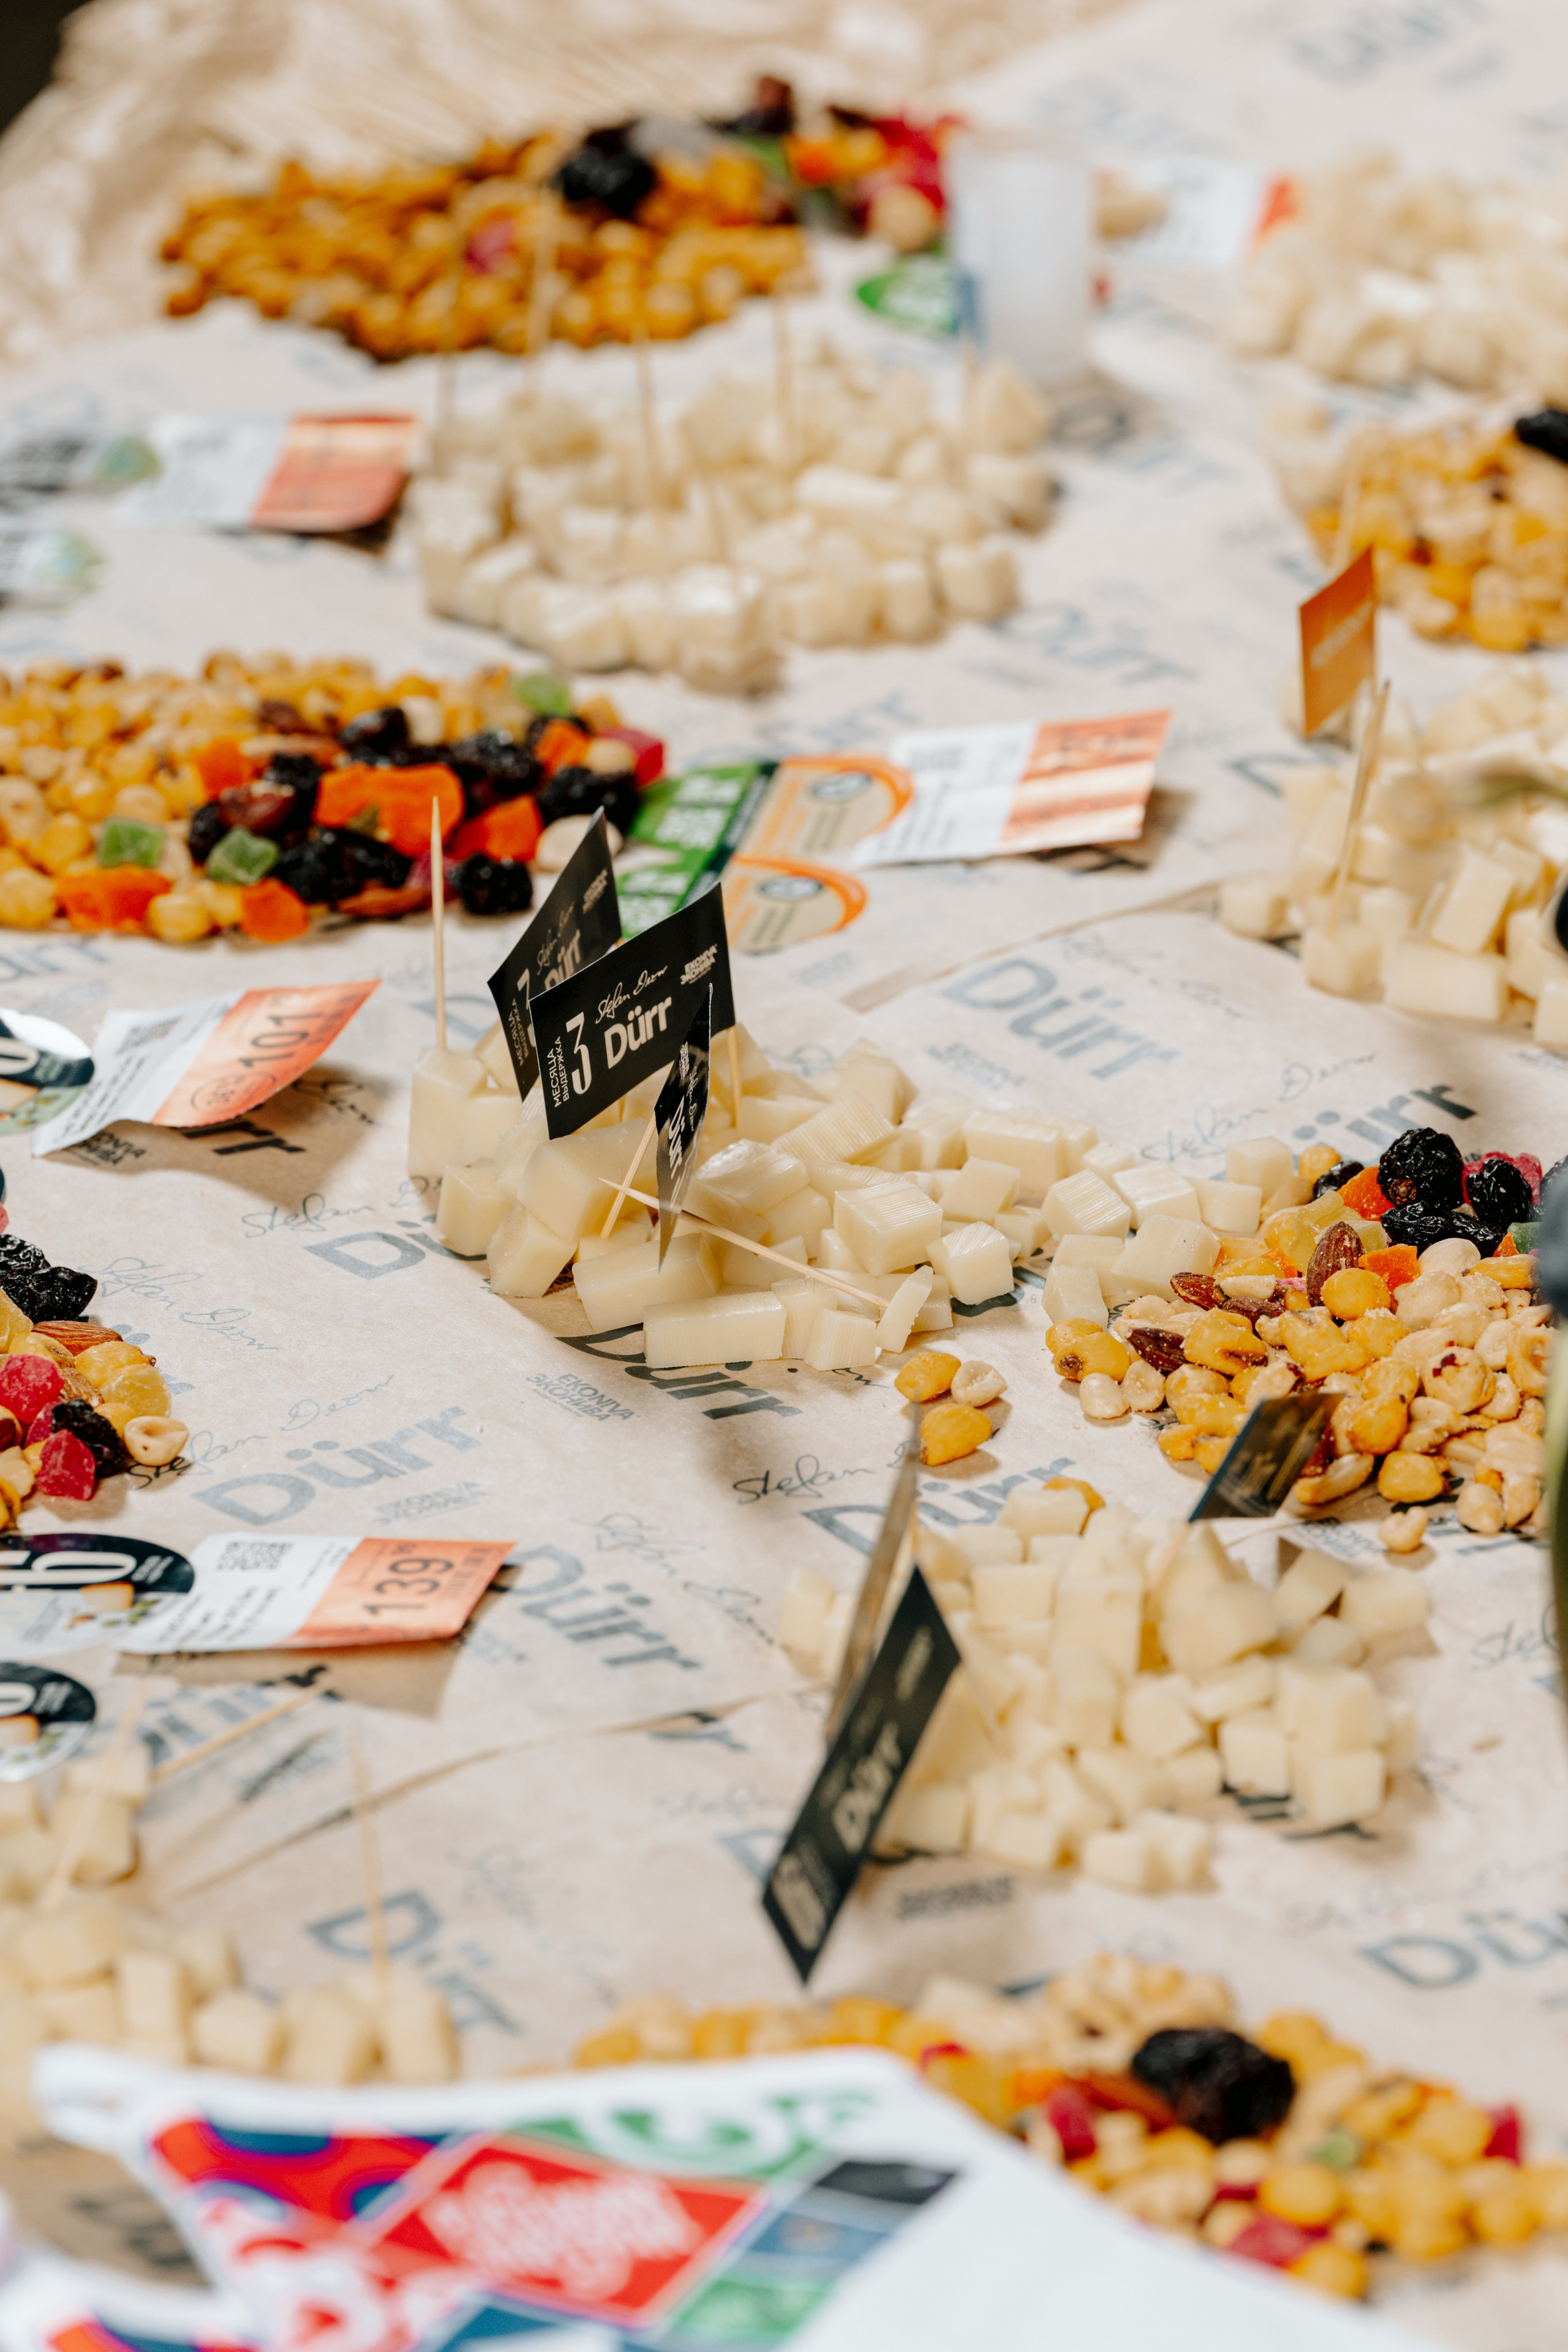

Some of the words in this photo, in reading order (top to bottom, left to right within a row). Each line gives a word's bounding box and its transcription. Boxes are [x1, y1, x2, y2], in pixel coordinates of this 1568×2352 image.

[603, 996, 673, 1069] Dürr
[938, 957, 1181, 1082] Dürr
[546, 1048, 562, 1107] МЕСЯЦА
[554, 1036, 570, 1102] ВЫДЕРЖКА
[565, 1012, 592, 1095] 3
[526, 1373, 611, 1422] ЭКОНИВА
[557, 1374, 635, 1420] EKONIVA
[190, 1406, 483, 1527] Dürr
[733, 1454, 875, 1504] Stefan
[363, 1556, 454, 1616] 139
